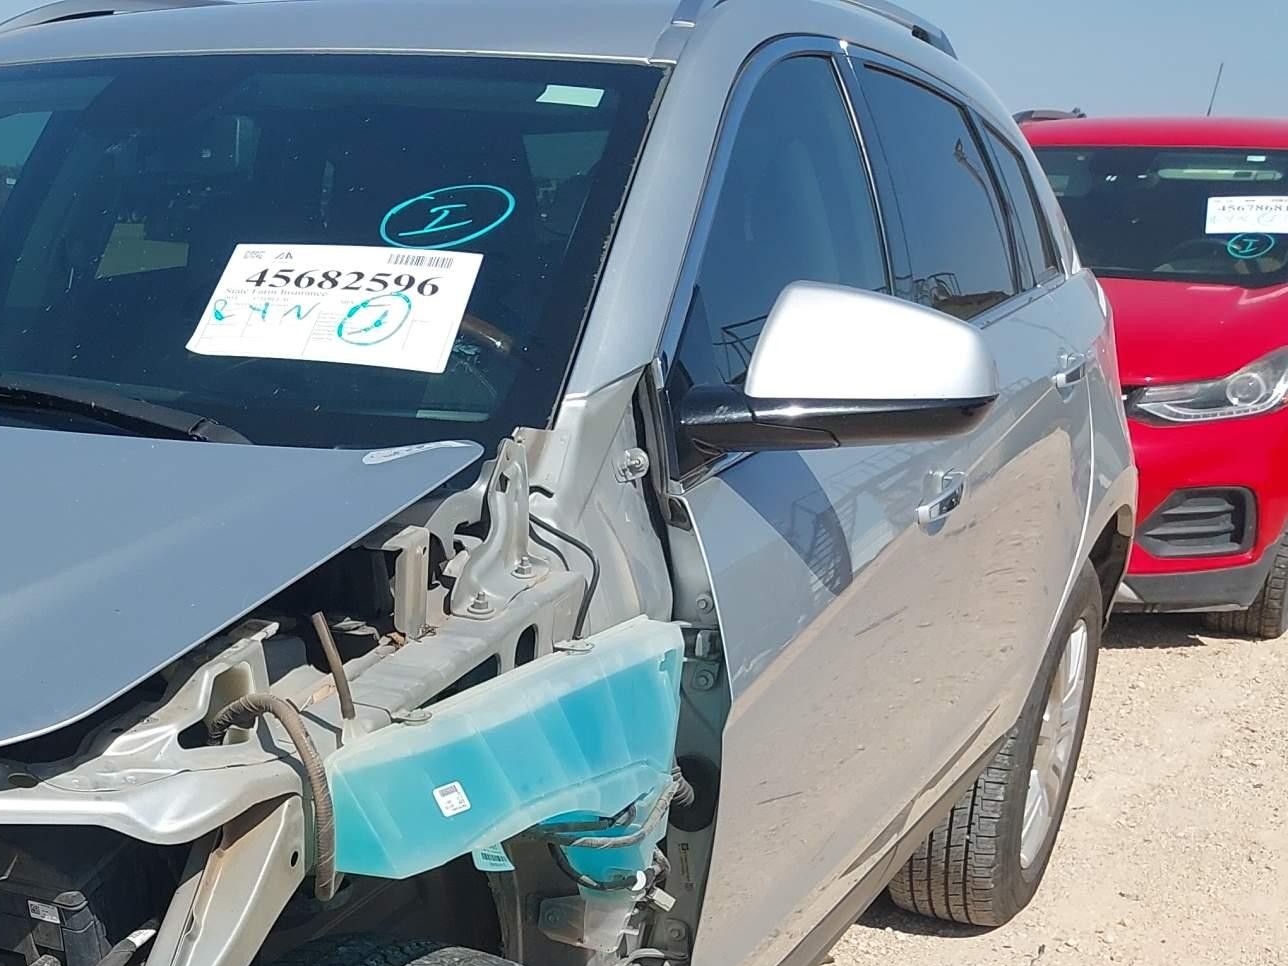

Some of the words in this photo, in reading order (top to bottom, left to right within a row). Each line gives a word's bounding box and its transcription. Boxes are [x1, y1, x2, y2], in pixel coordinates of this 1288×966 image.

[245, 267, 441, 297] 45682596
[225, 287, 249, 295] State
[280, 289, 329, 298] Insurance
